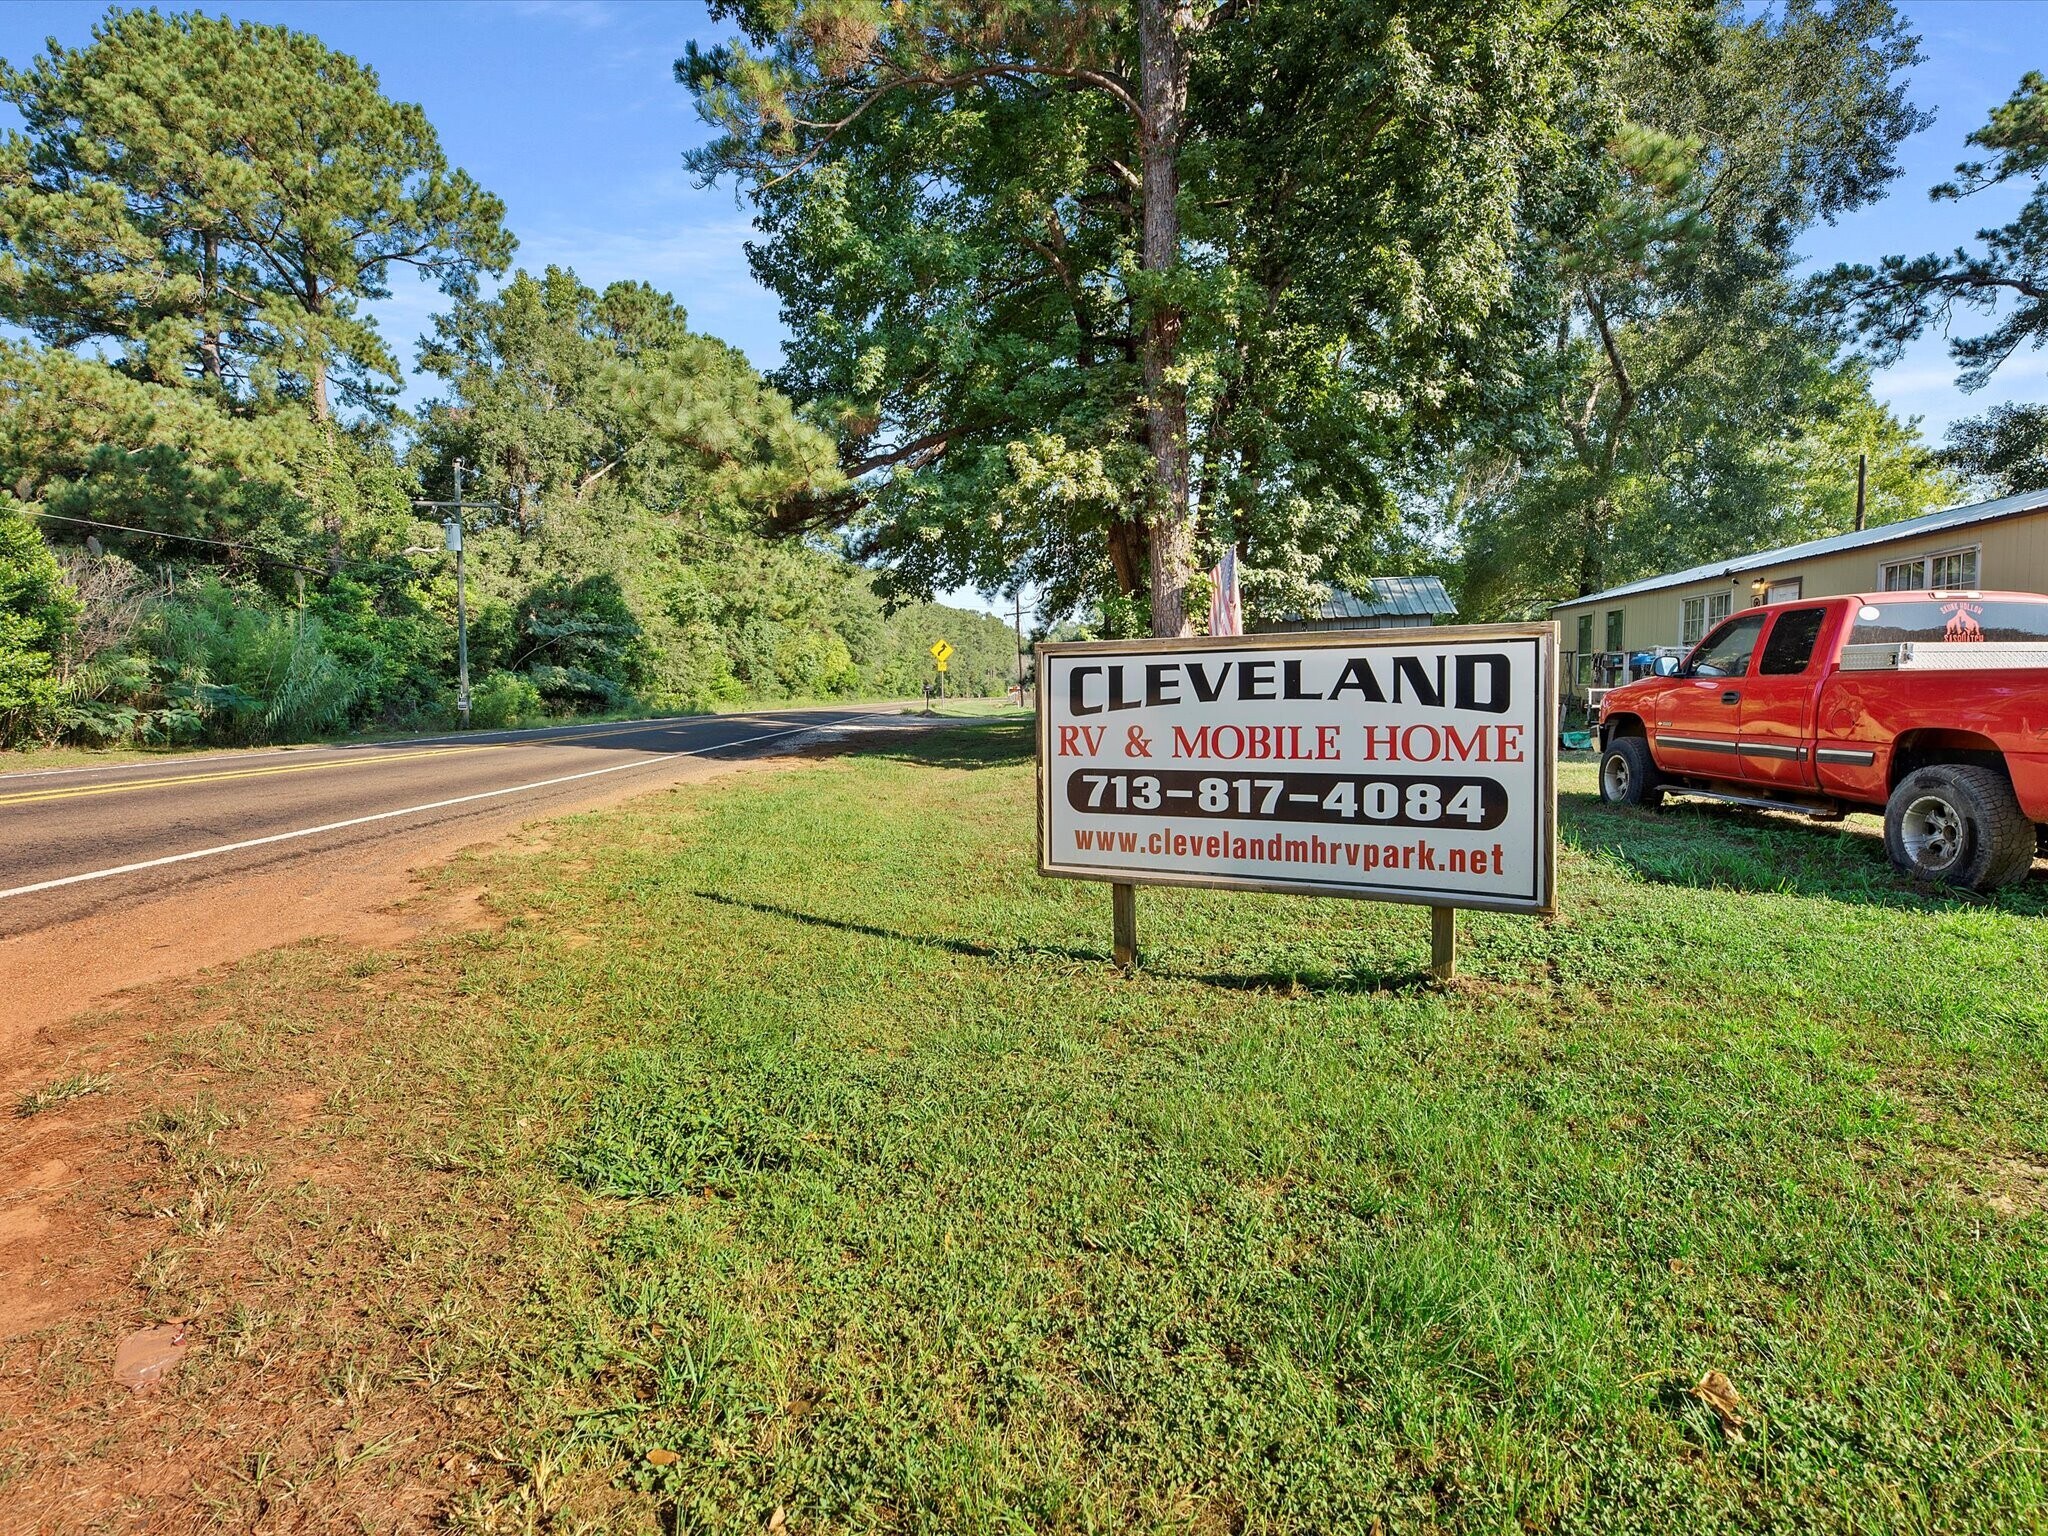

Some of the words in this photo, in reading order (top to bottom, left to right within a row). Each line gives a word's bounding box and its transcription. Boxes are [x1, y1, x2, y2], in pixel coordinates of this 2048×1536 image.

[1944, 634, 1984, 642] SASQUATCH
[1069, 653, 1511, 717] CLEVELAND
[1058, 725, 1107, 757] RV
[1124, 725, 1152, 758] &
[1171, 725, 1341, 761] MOBILE
[1363, 724, 1524, 763] HOME
[1082, 775, 1485, 823] 713-817-4084
[1074, 828, 1504, 876] www.clevelandmhrvpark.net
